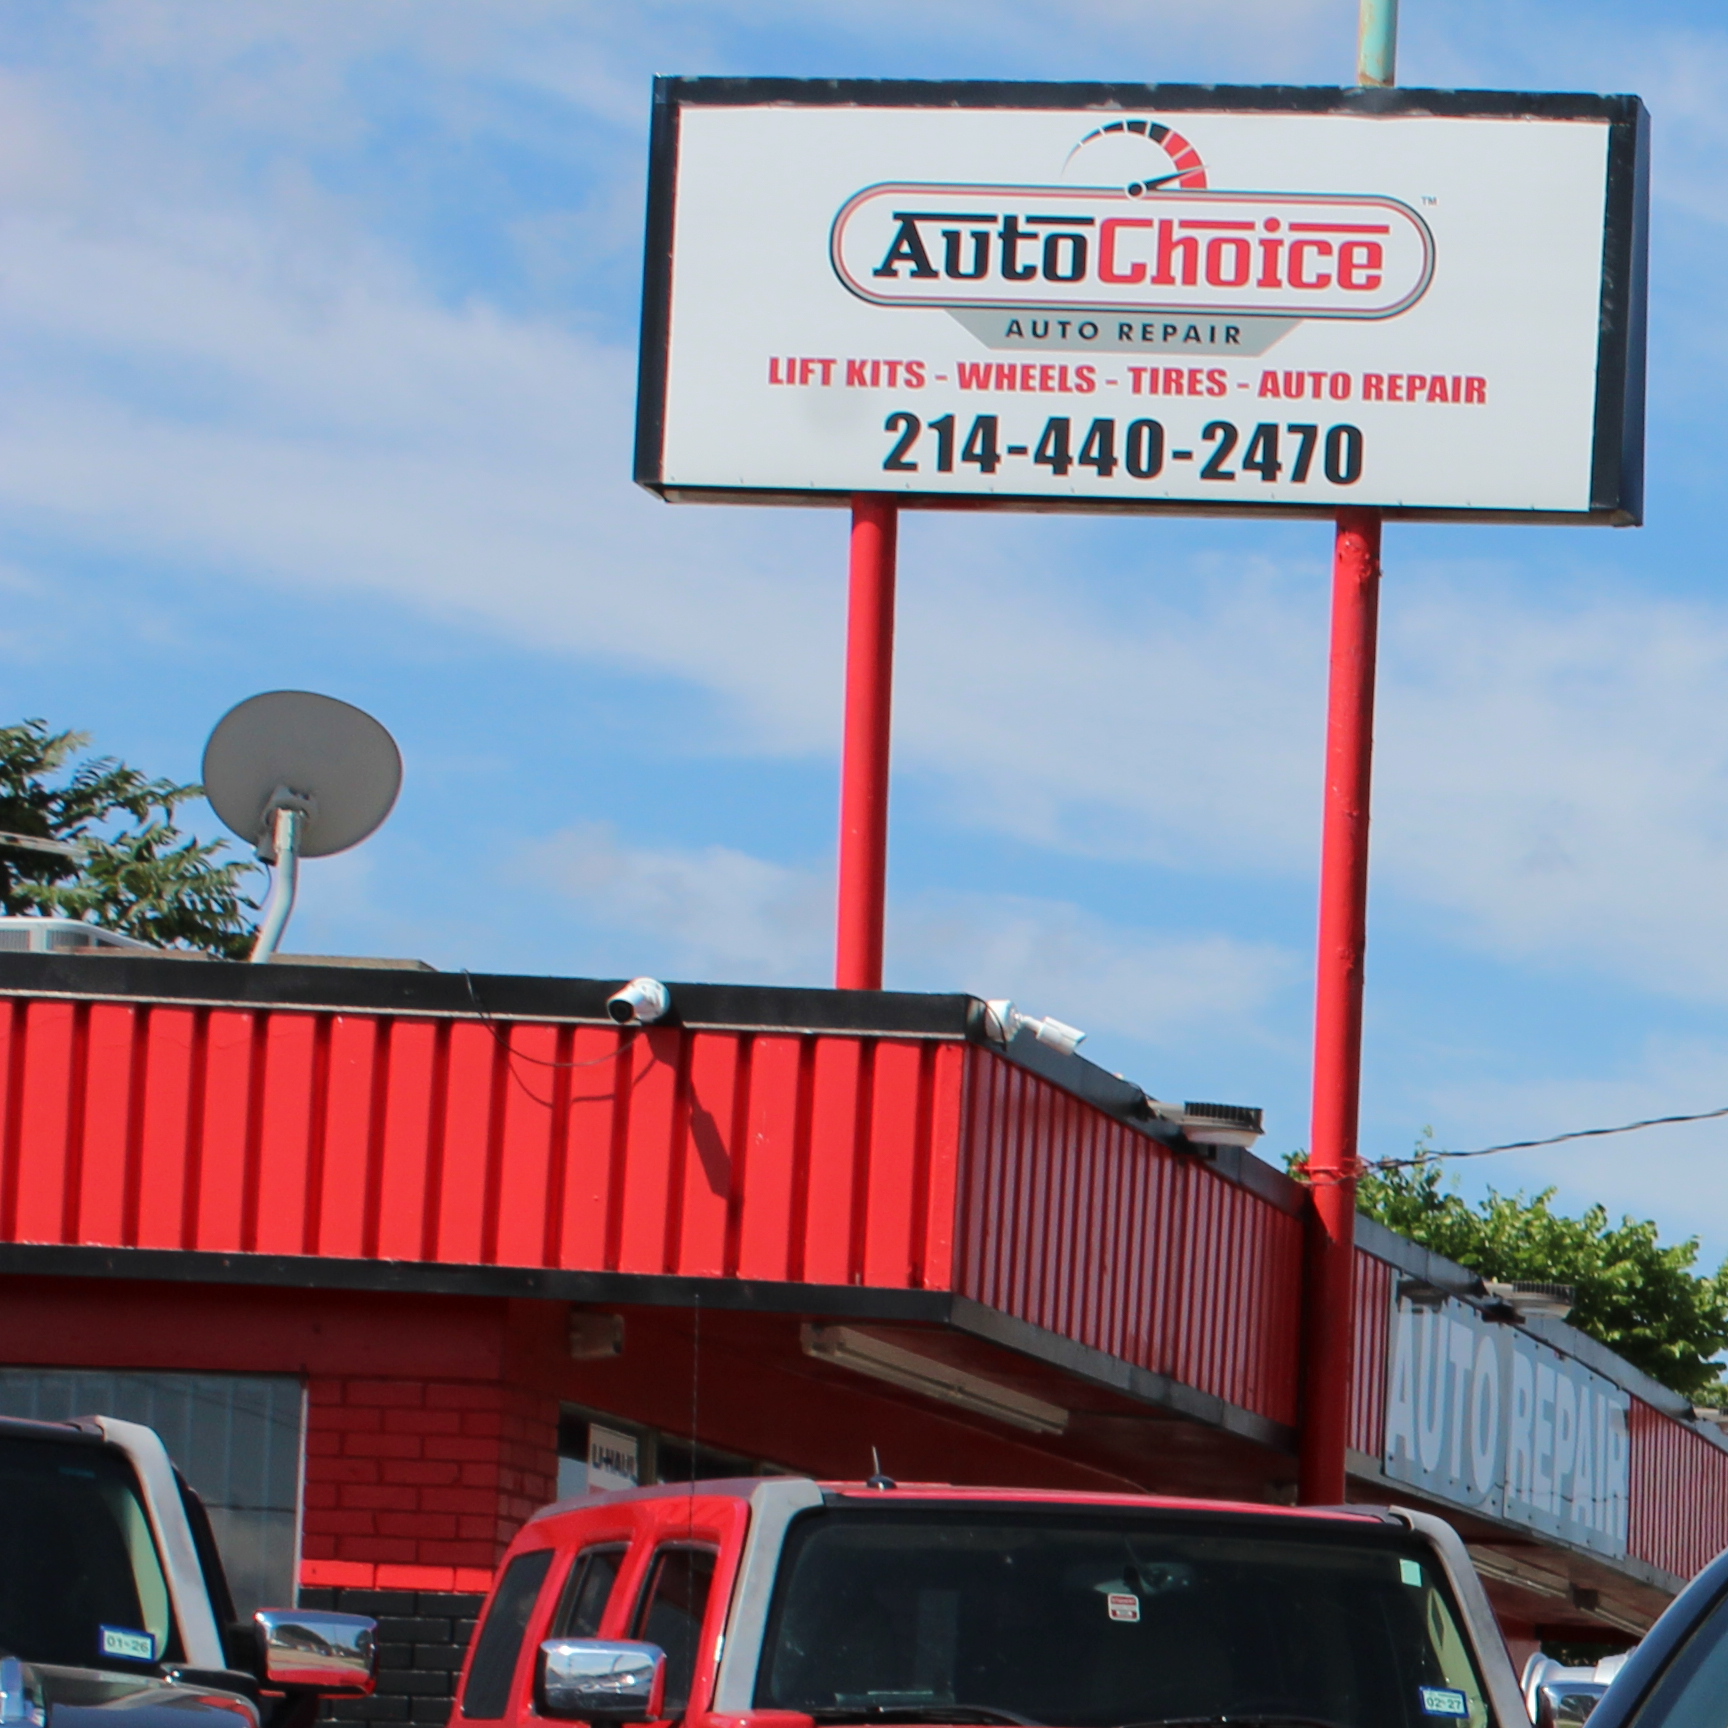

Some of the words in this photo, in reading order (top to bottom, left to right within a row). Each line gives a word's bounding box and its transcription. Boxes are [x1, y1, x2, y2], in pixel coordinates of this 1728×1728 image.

[872, 212, 1389, 293] AutoChoice
[1005, 318, 1099, 340] AUTO
[1117, 321, 1242, 346] REPAIR
[768, 357, 837, 388] LIFT
[846, 359, 927, 390] KITS
[957, 361, 1097, 394] WHEELS
[1127, 366, 1228, 398] TIRES
[1257, 369, 1352, 401] AUTO
[1361, 372, 1488, 405] REPAIR
[881, 410, 1364, 486] 214-440-2470
[1386, 1296, 1499, 1495] AUTO
[1507, 1350, 1630, 1541] REPAIR
